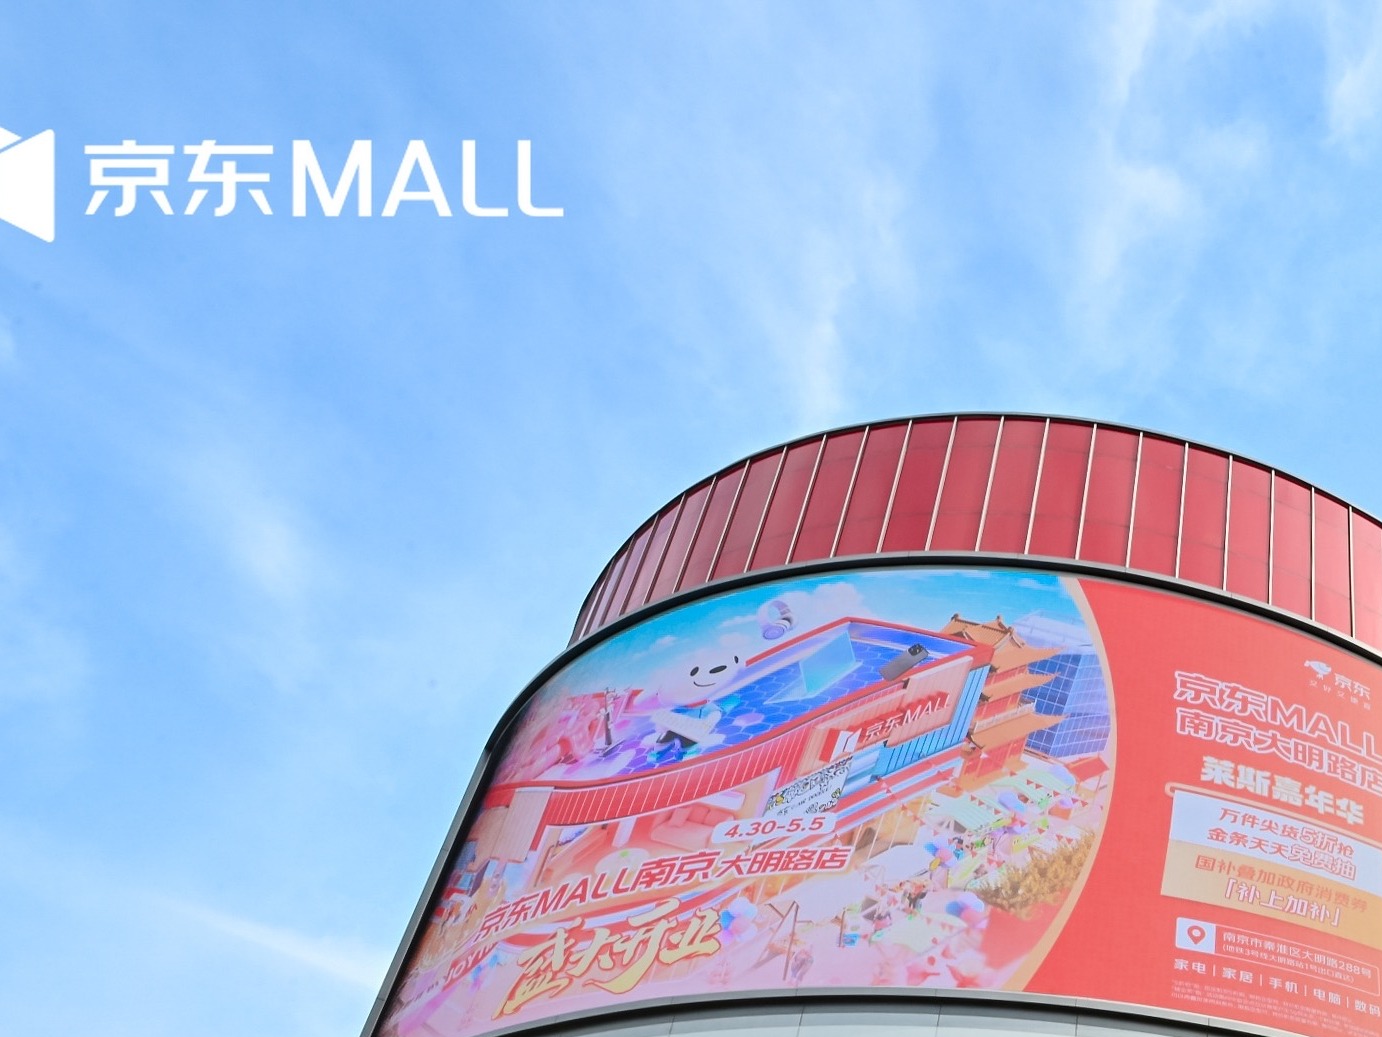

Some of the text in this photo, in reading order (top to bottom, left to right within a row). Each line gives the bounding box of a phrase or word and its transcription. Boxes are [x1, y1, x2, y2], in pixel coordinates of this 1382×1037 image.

[1335, 672, 1371, 701] 京东
[862, 693, 951, 743] 京东MALL
[1201, 755, 1365, 826] 莱斯嘉年华
[724, 815, 827, 840] 4.30-5.5
[1206, 826, 1357, 882] 金条天天免费抽
[1218, 807, 1355, 860] 万件尖货5折抢
[473, 847, 850, 942] 京东MALL南京大明路店
[1194, 854, 1369, 914] 国补叠加政府消费券
[491, 896, 722, 1021] 盛大开业
[1173, 957, 1382, 1019] 家电 家居 手机 电脑 数码
